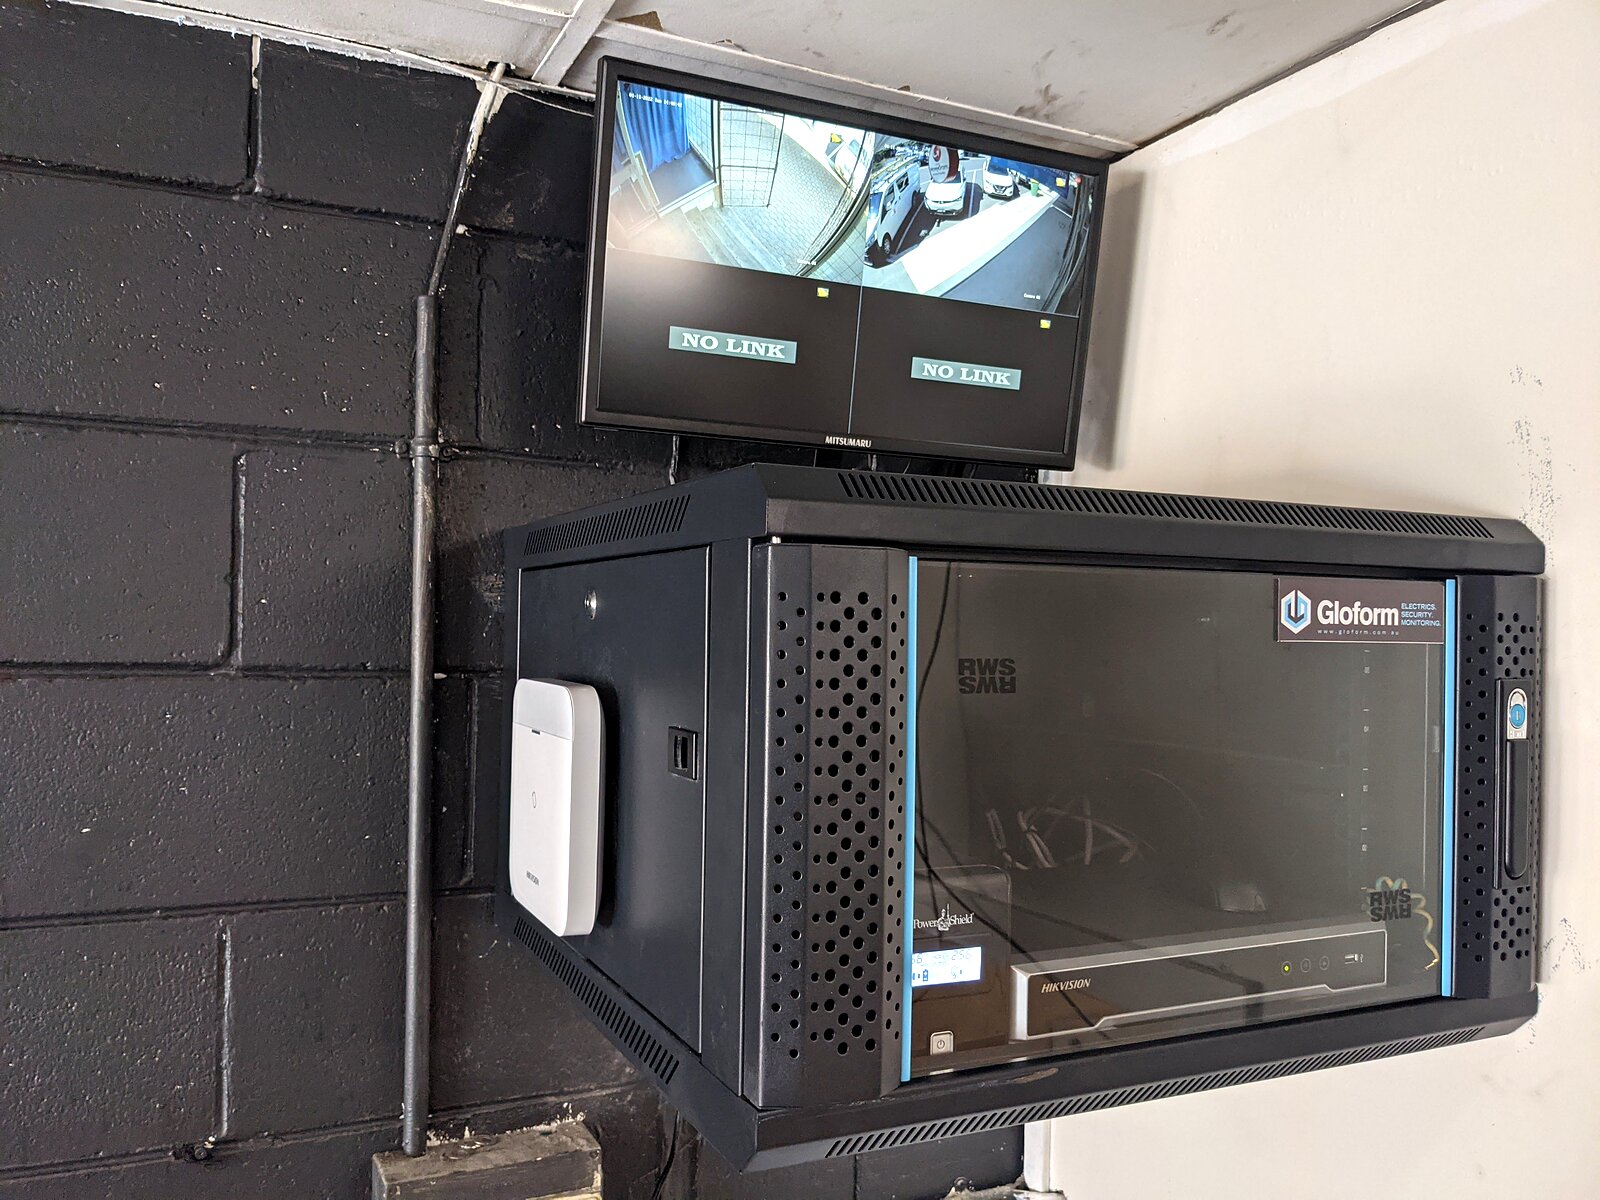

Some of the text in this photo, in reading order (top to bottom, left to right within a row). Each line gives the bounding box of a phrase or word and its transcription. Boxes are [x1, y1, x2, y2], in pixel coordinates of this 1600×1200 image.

[682, 333, 785, 359] NO LINK
[922, 363, 1011, 385] NO LINK
[825, 436, 872, 448] MITSUMARU
[1317, 600, 1398, 626] Gloform
[959, 658, 1016, 675] RWS
[1370, 889, 1411, 906] RWS
[913, 918, 938, 929] Power
[1041, 978, 1091, 993] HIKVISION
